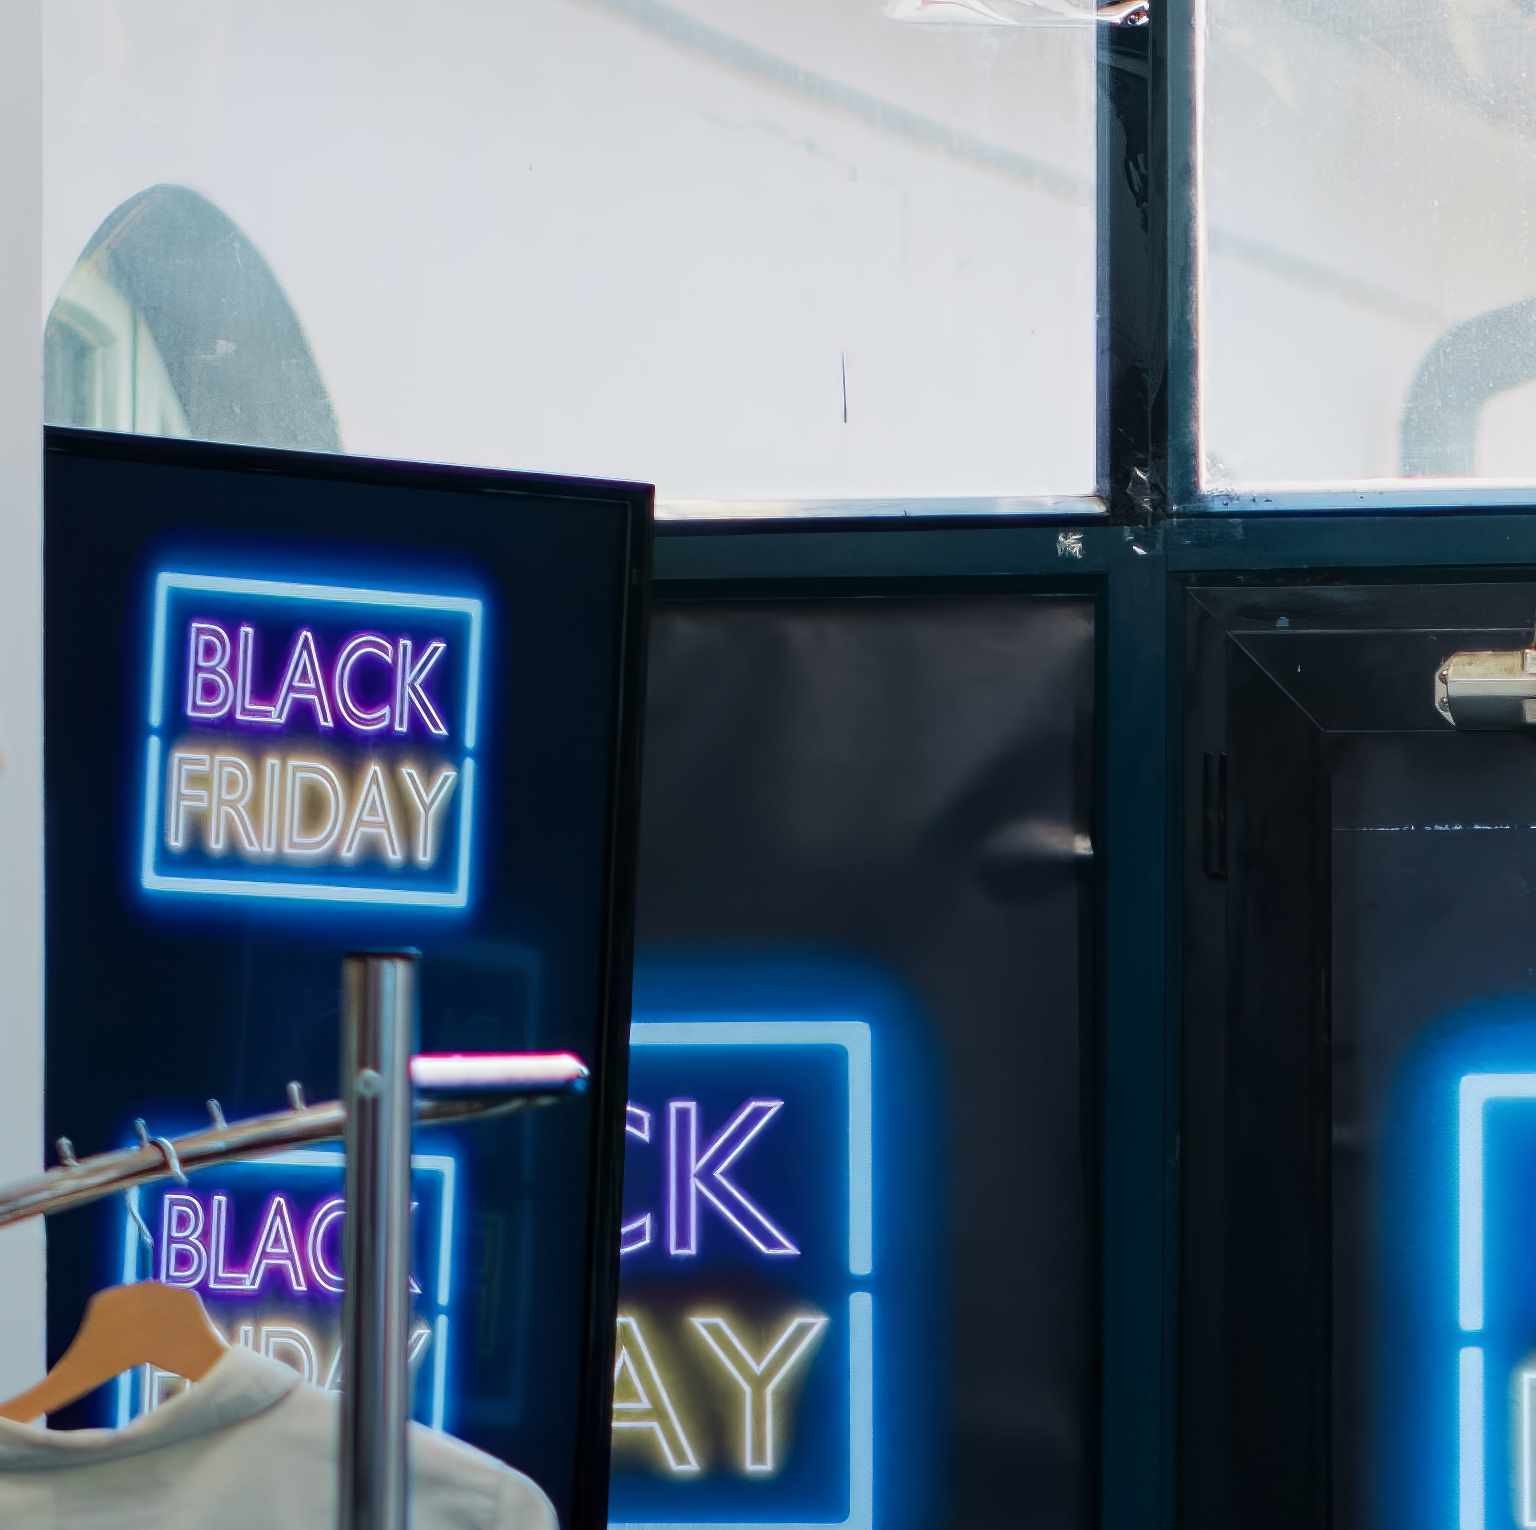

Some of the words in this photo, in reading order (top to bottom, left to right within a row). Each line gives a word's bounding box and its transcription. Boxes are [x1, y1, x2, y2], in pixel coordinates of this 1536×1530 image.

[186, 621, 449, 736] BLACK
[167, 752, 458, 862] FRIDAY
[160, 1194, 424, 1294] BLAC
